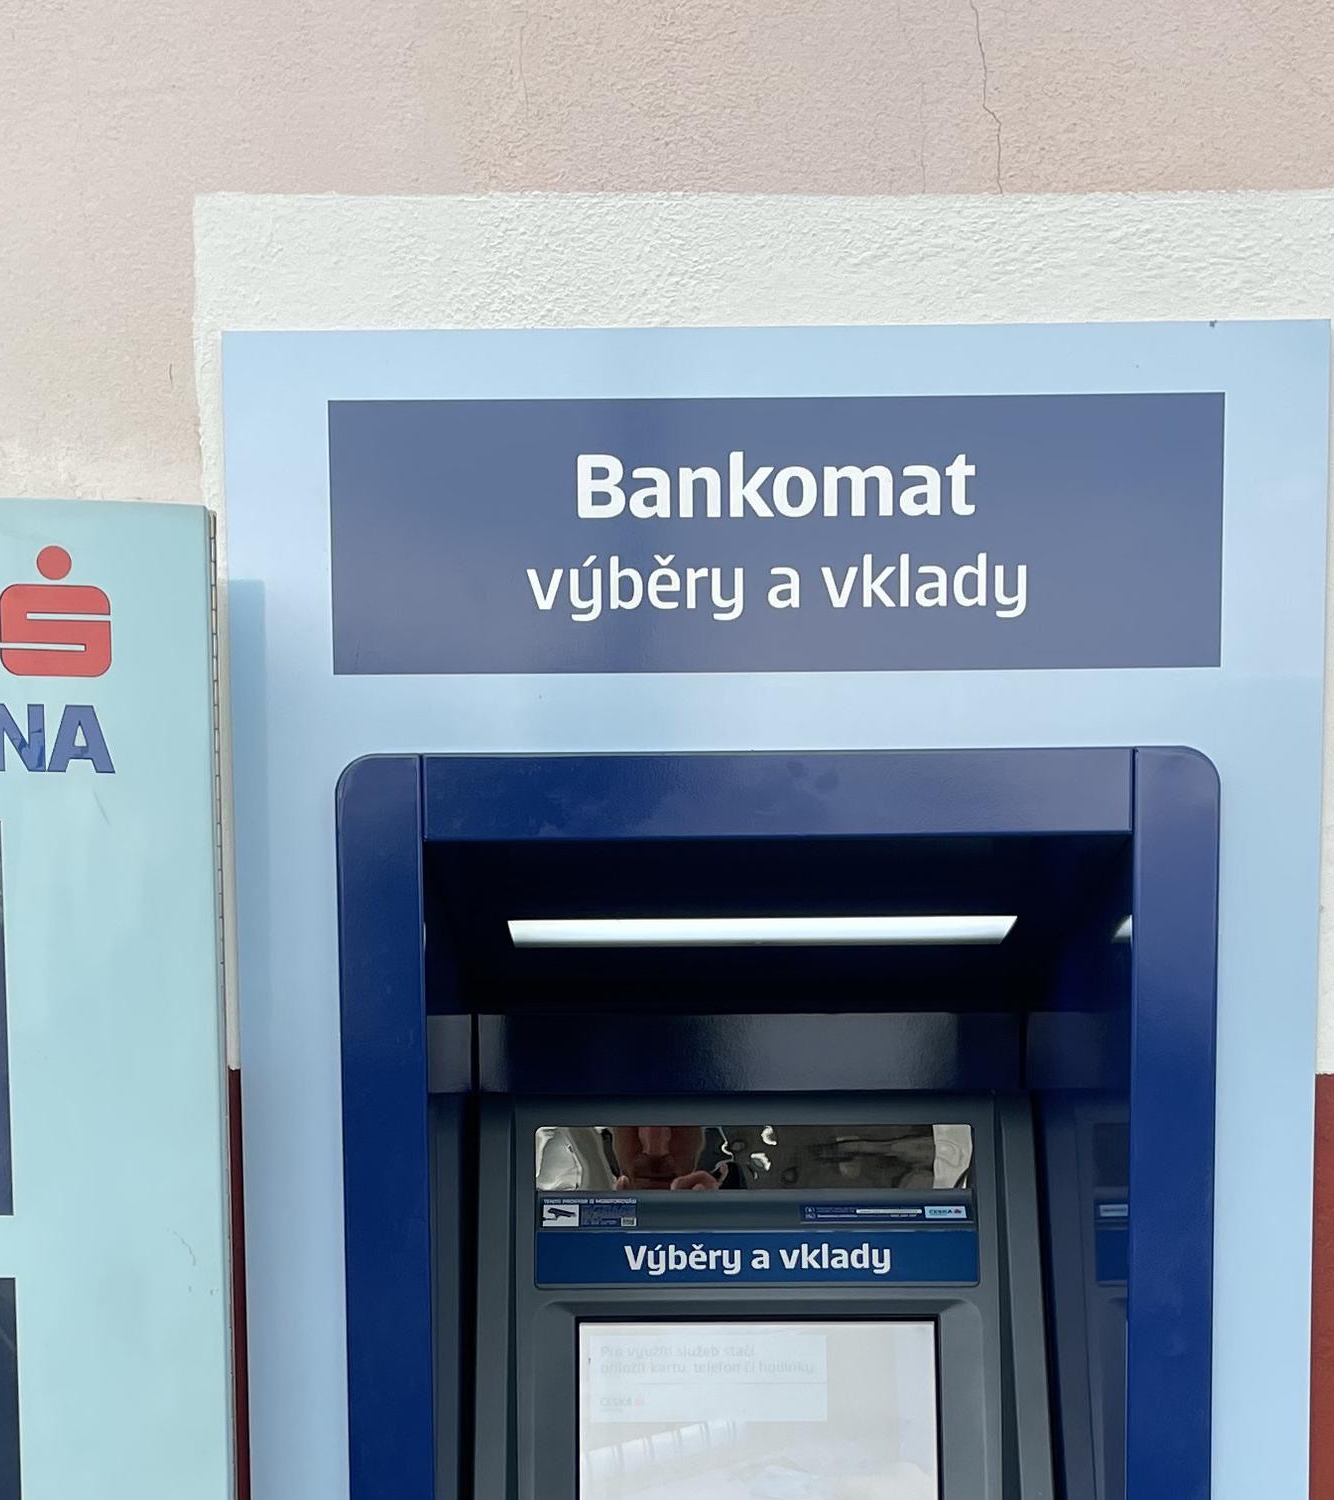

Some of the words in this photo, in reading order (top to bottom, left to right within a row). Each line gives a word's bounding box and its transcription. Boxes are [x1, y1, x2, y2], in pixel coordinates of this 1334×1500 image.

[574, 450, 976, 520] Bankomat
[525, 555, 743, 621] výběry
[768, 567, 800, 609] a
[820, 552, 1029, 617] vklady
[624, 1243, 741, 1275] Výběry
[751, 1250, 770, 1270] a
[780, 1243, 892, 1273] vklady
